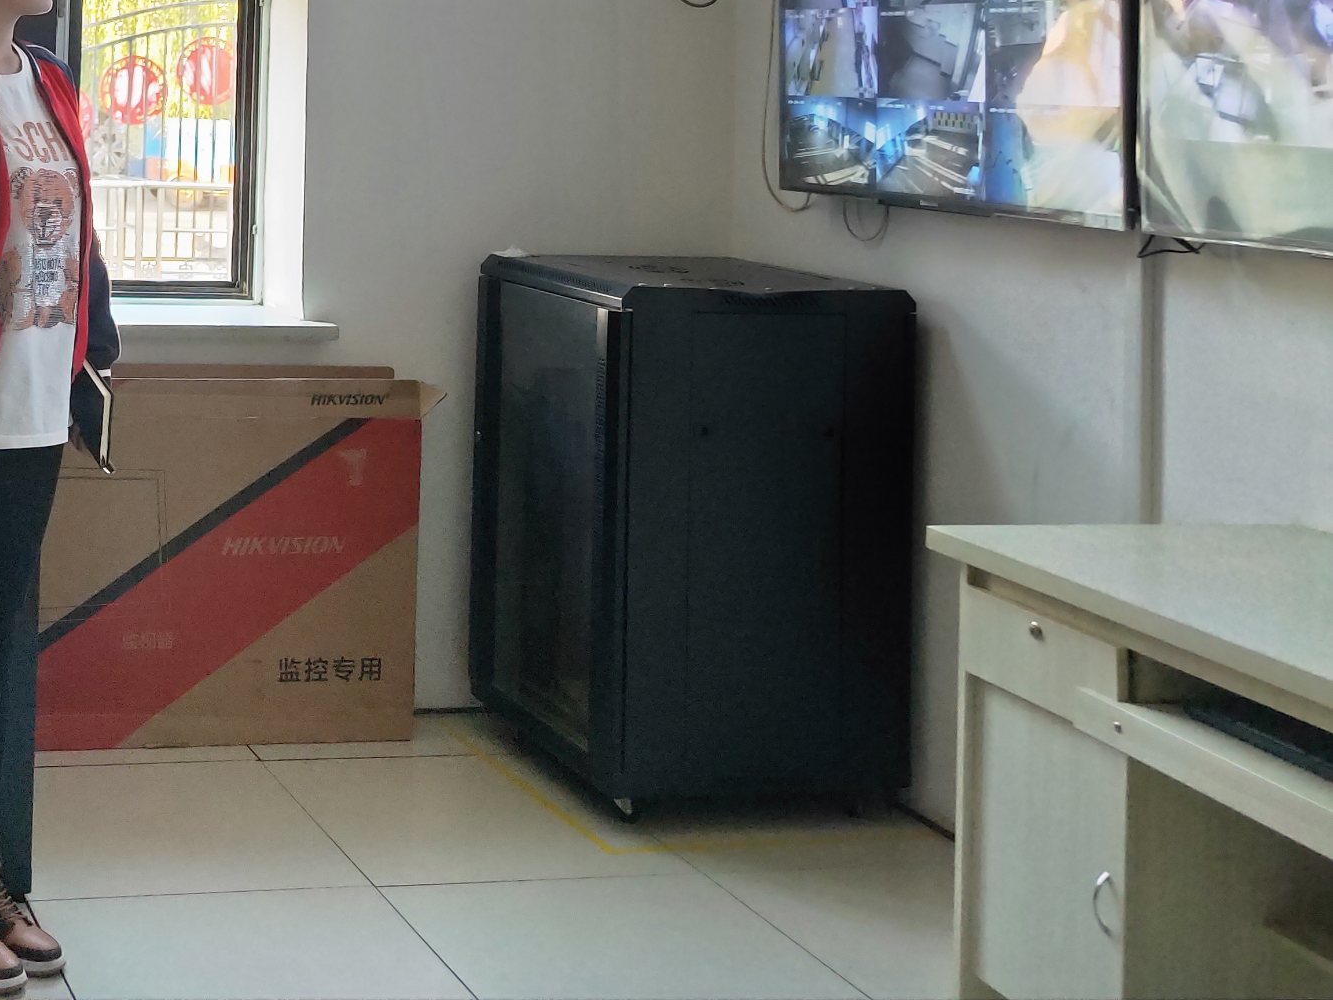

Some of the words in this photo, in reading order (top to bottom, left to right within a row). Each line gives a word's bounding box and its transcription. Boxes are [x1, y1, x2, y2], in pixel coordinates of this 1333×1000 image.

[310, 393, 386, 406] HIKVISION
[222, 536, 346, 555] HIKVISION
[278, 656, 382, 682] 监控专用
